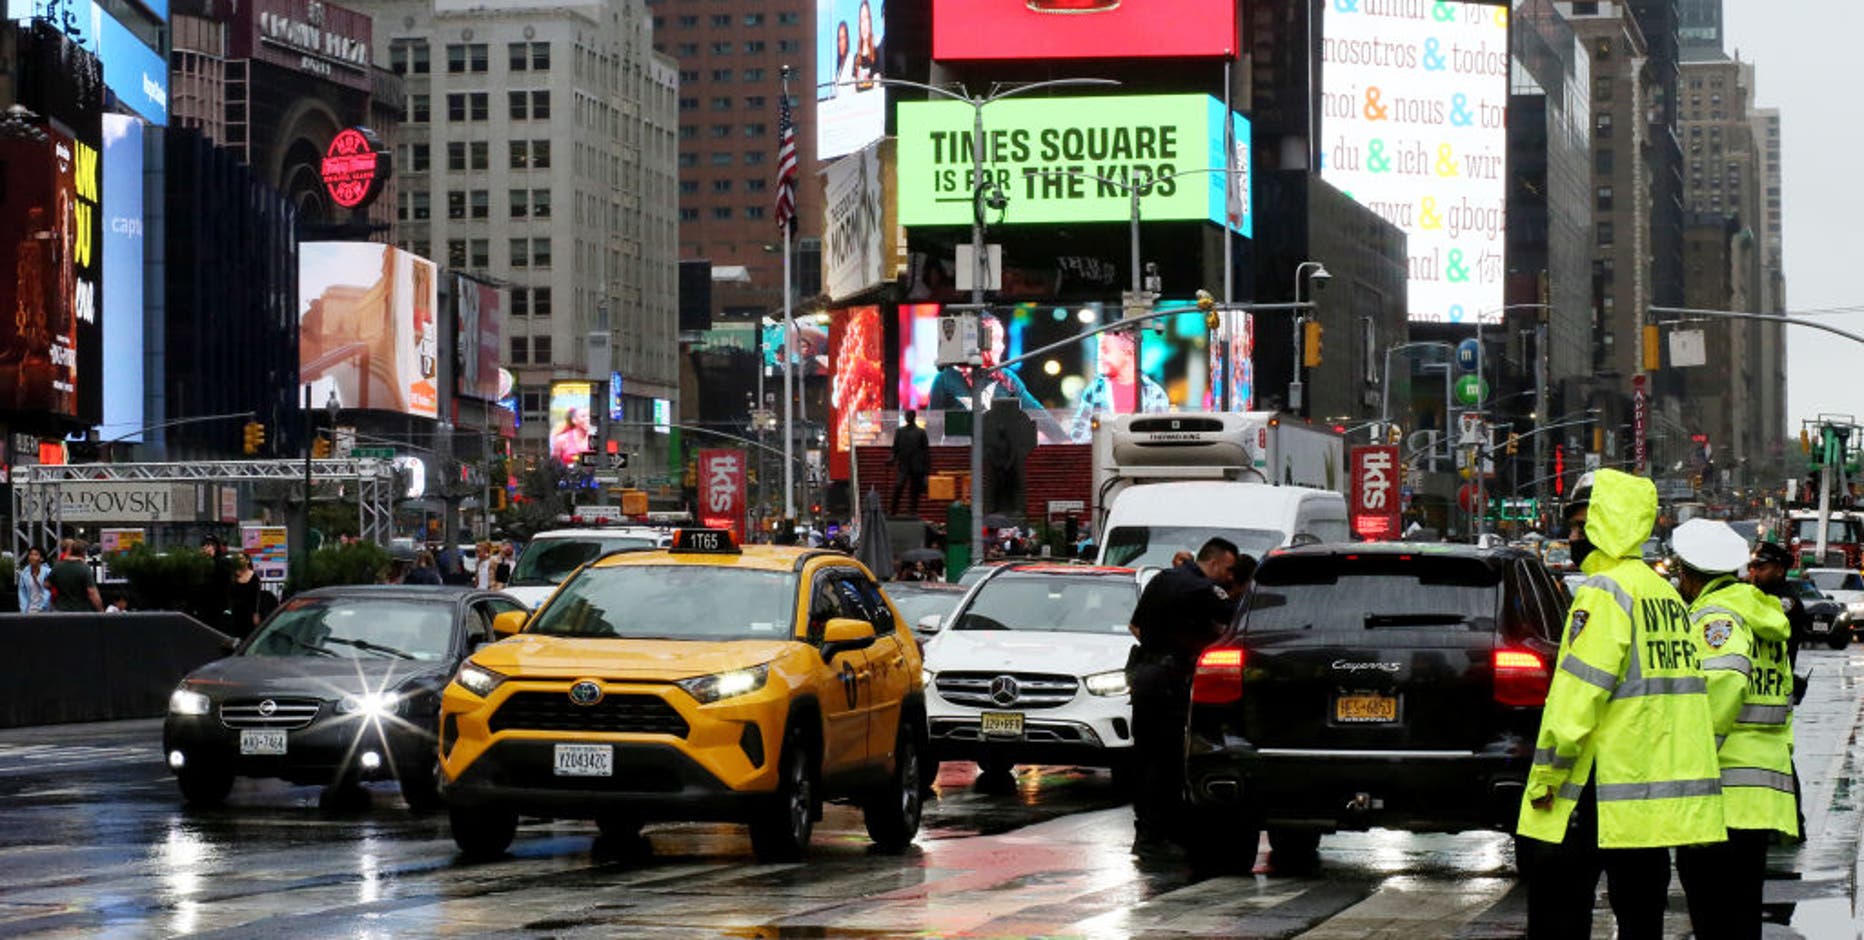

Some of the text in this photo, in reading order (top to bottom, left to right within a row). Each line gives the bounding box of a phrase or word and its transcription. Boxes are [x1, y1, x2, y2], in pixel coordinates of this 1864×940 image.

[1422, 37, 1447, 71] &
[1363, 86, 1388, 121] &
[1394, 97, 1445, 125] nous
[1450, 92, 1474, 127] &
[930, 126, 1177, 164] TIMES SQUARE
[1333, 136, 1502, 179] du & ich & wir
[935, 170, 957, 192] IS
[1022, 166, 1085, 200] THE
[1097, 163, 1177, 198] KIDS
[1418, 196, 1443, 230] &
[1446, 248, 1470, 283] &
[710, 455, 738, 512] tkts
[1363, 451, 1391, 509] tkts
[690, 533, 718, 549] 1T65
